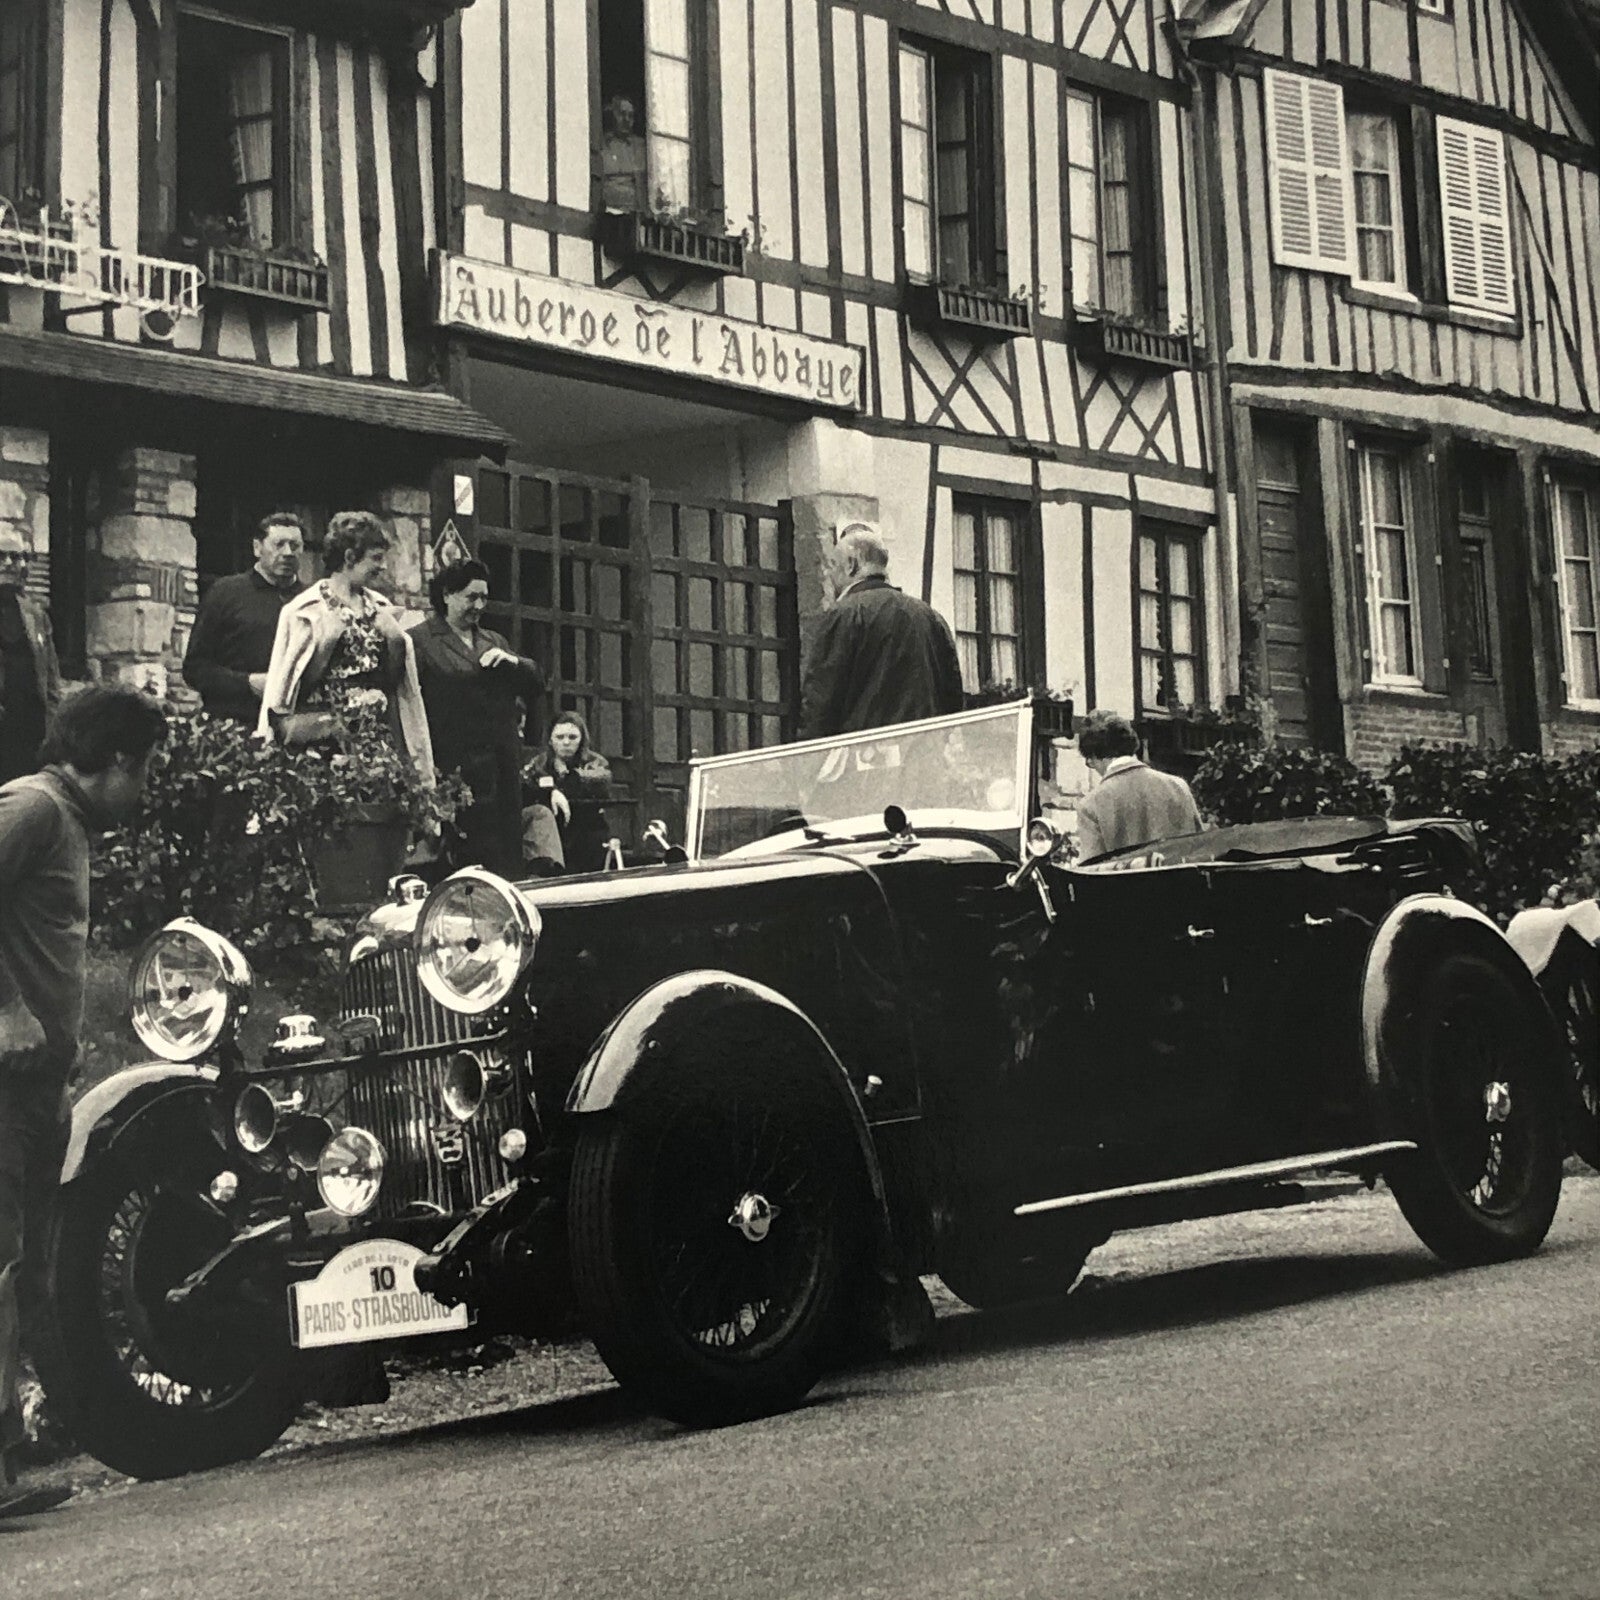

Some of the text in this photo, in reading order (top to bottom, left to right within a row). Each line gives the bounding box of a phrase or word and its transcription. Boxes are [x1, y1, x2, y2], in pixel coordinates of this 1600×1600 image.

[454, 266, 620, 348] Auberge
[634, 303, 671, 359] de
[370, 1265, 396, 1293] 10
